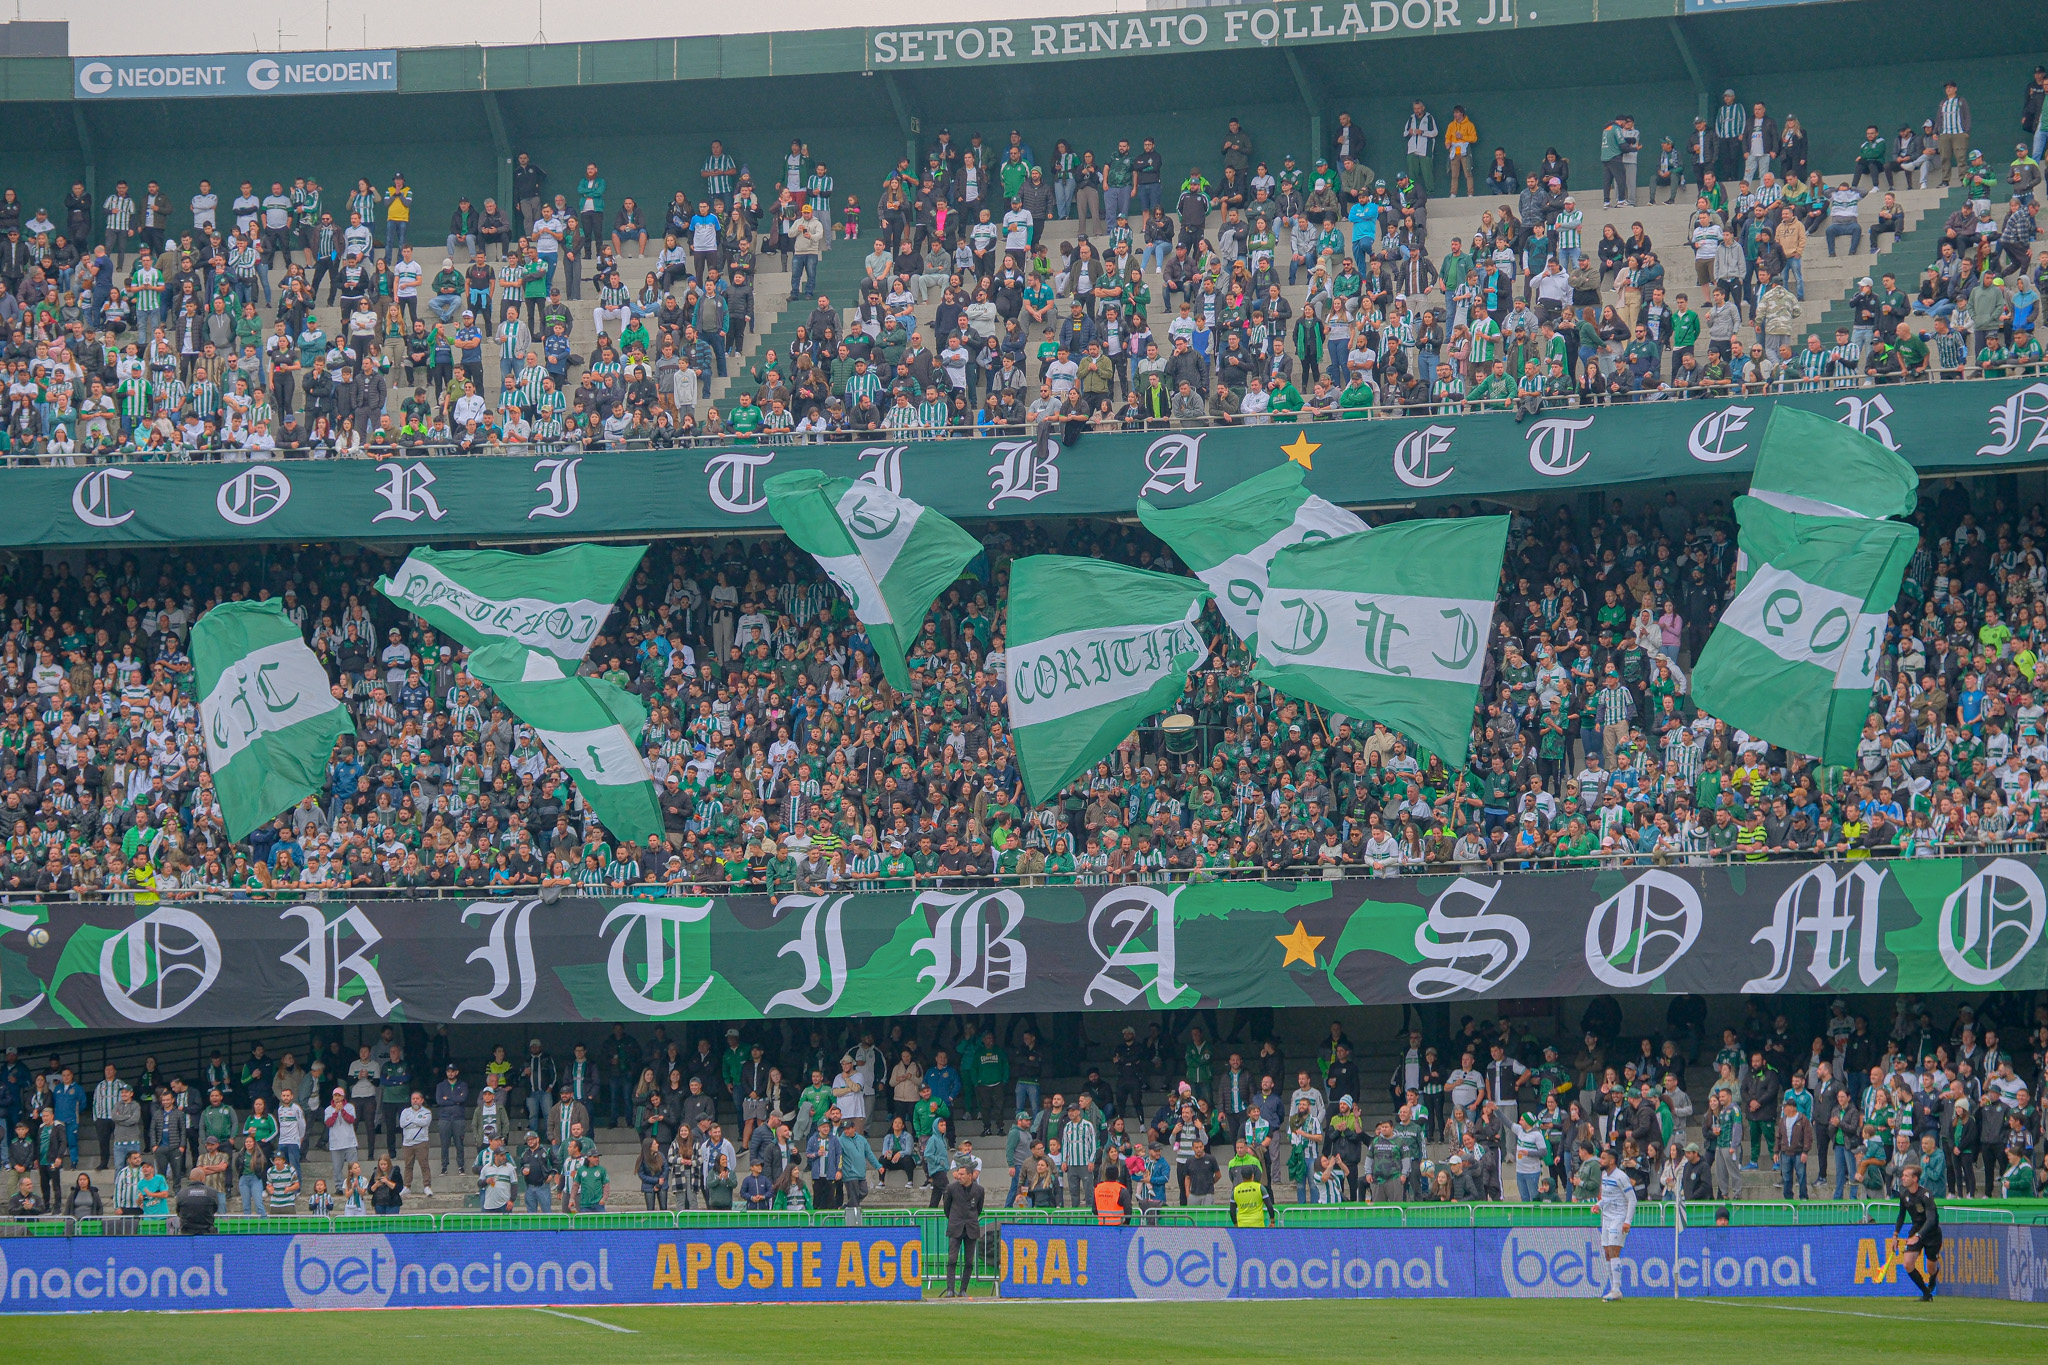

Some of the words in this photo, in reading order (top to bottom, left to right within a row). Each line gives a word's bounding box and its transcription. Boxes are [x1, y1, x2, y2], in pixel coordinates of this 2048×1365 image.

[874, 27, 1016, 63] SETOR
[1031, 13, 1208, 56] RENATO
[1224, 0, 1462, 42] FOLLADOR
[652, 1241, 823, 1290] APOSTE
[1957, 1237, 2000, 1285] AGORA!
